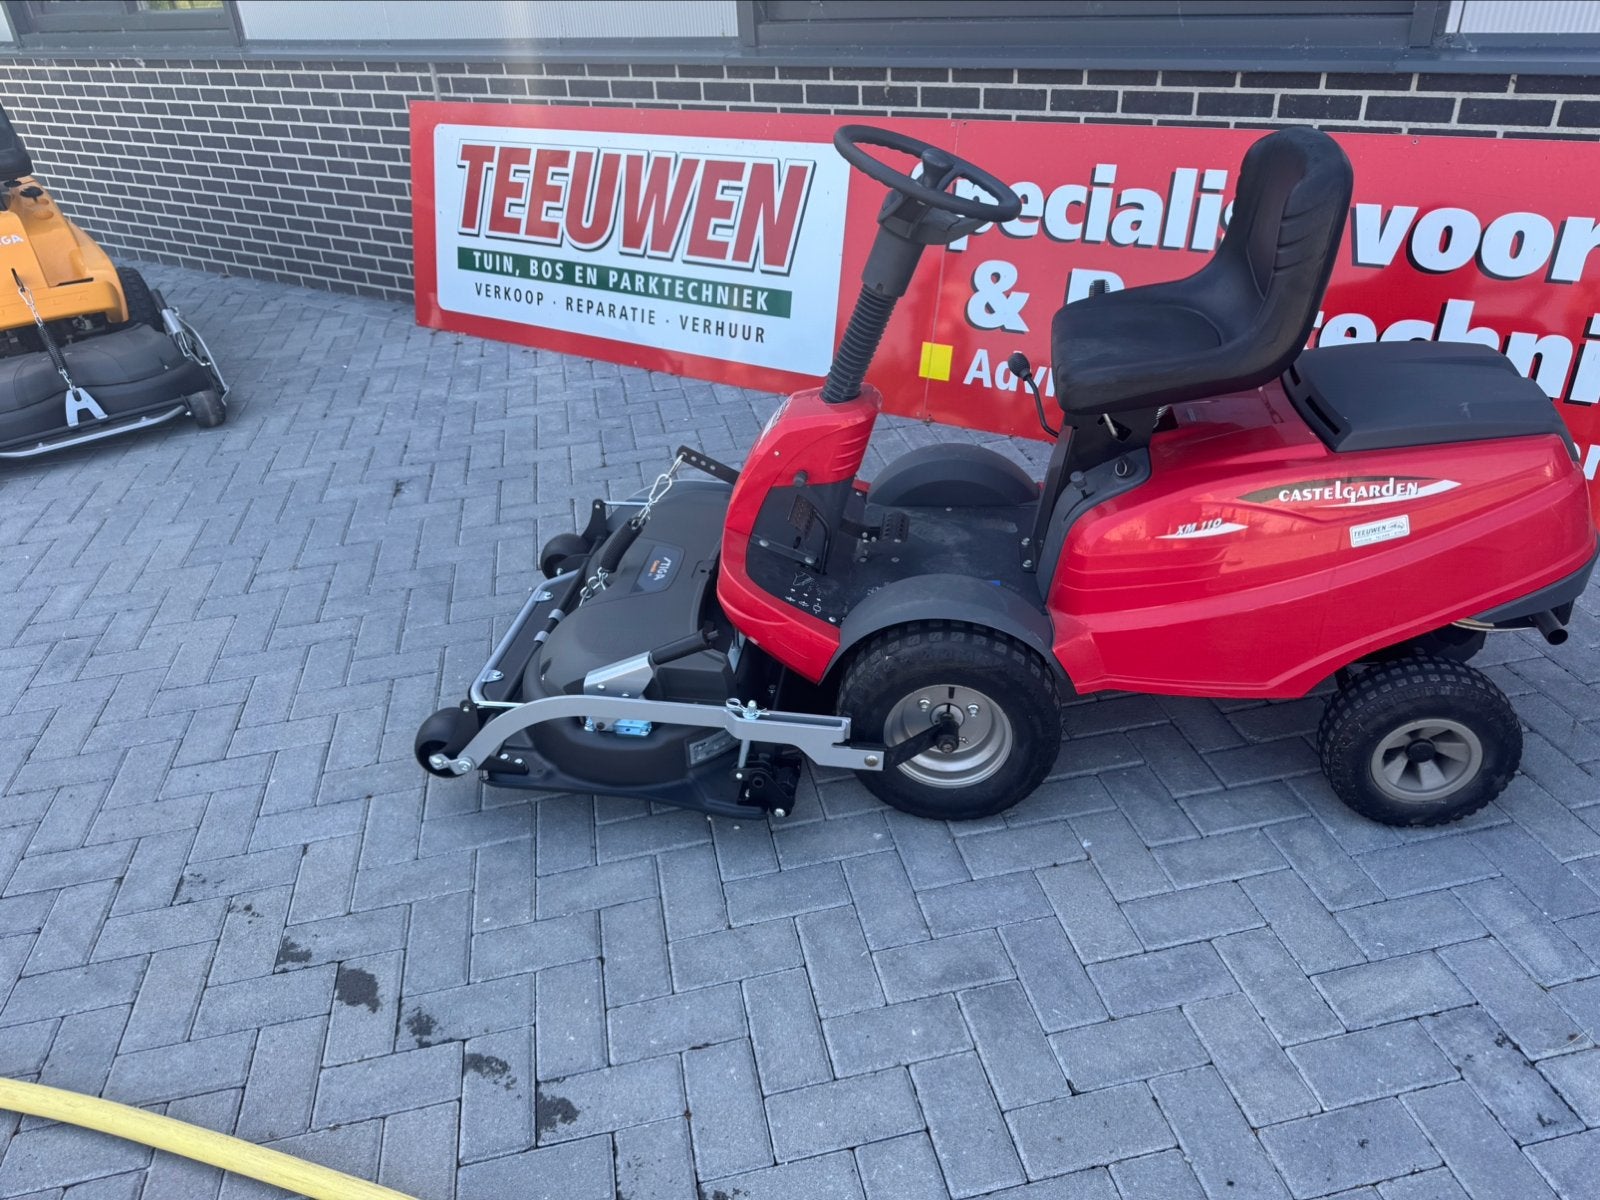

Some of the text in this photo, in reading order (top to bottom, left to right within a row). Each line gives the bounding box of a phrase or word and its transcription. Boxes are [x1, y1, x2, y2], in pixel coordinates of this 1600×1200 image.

[458, 140, 814, 274] TEEUWEN
[910, 161, 1600, 282] peciali voor
[473, 250, 770, 312] TUIN, BOS EN PARKTECHNIEK
[475, 282, 765, 344] VERKOOP REPARATIE VERHUUR
[967, 260, 1030, 332] &
[1175, 517, 1223, 536] XM 110
